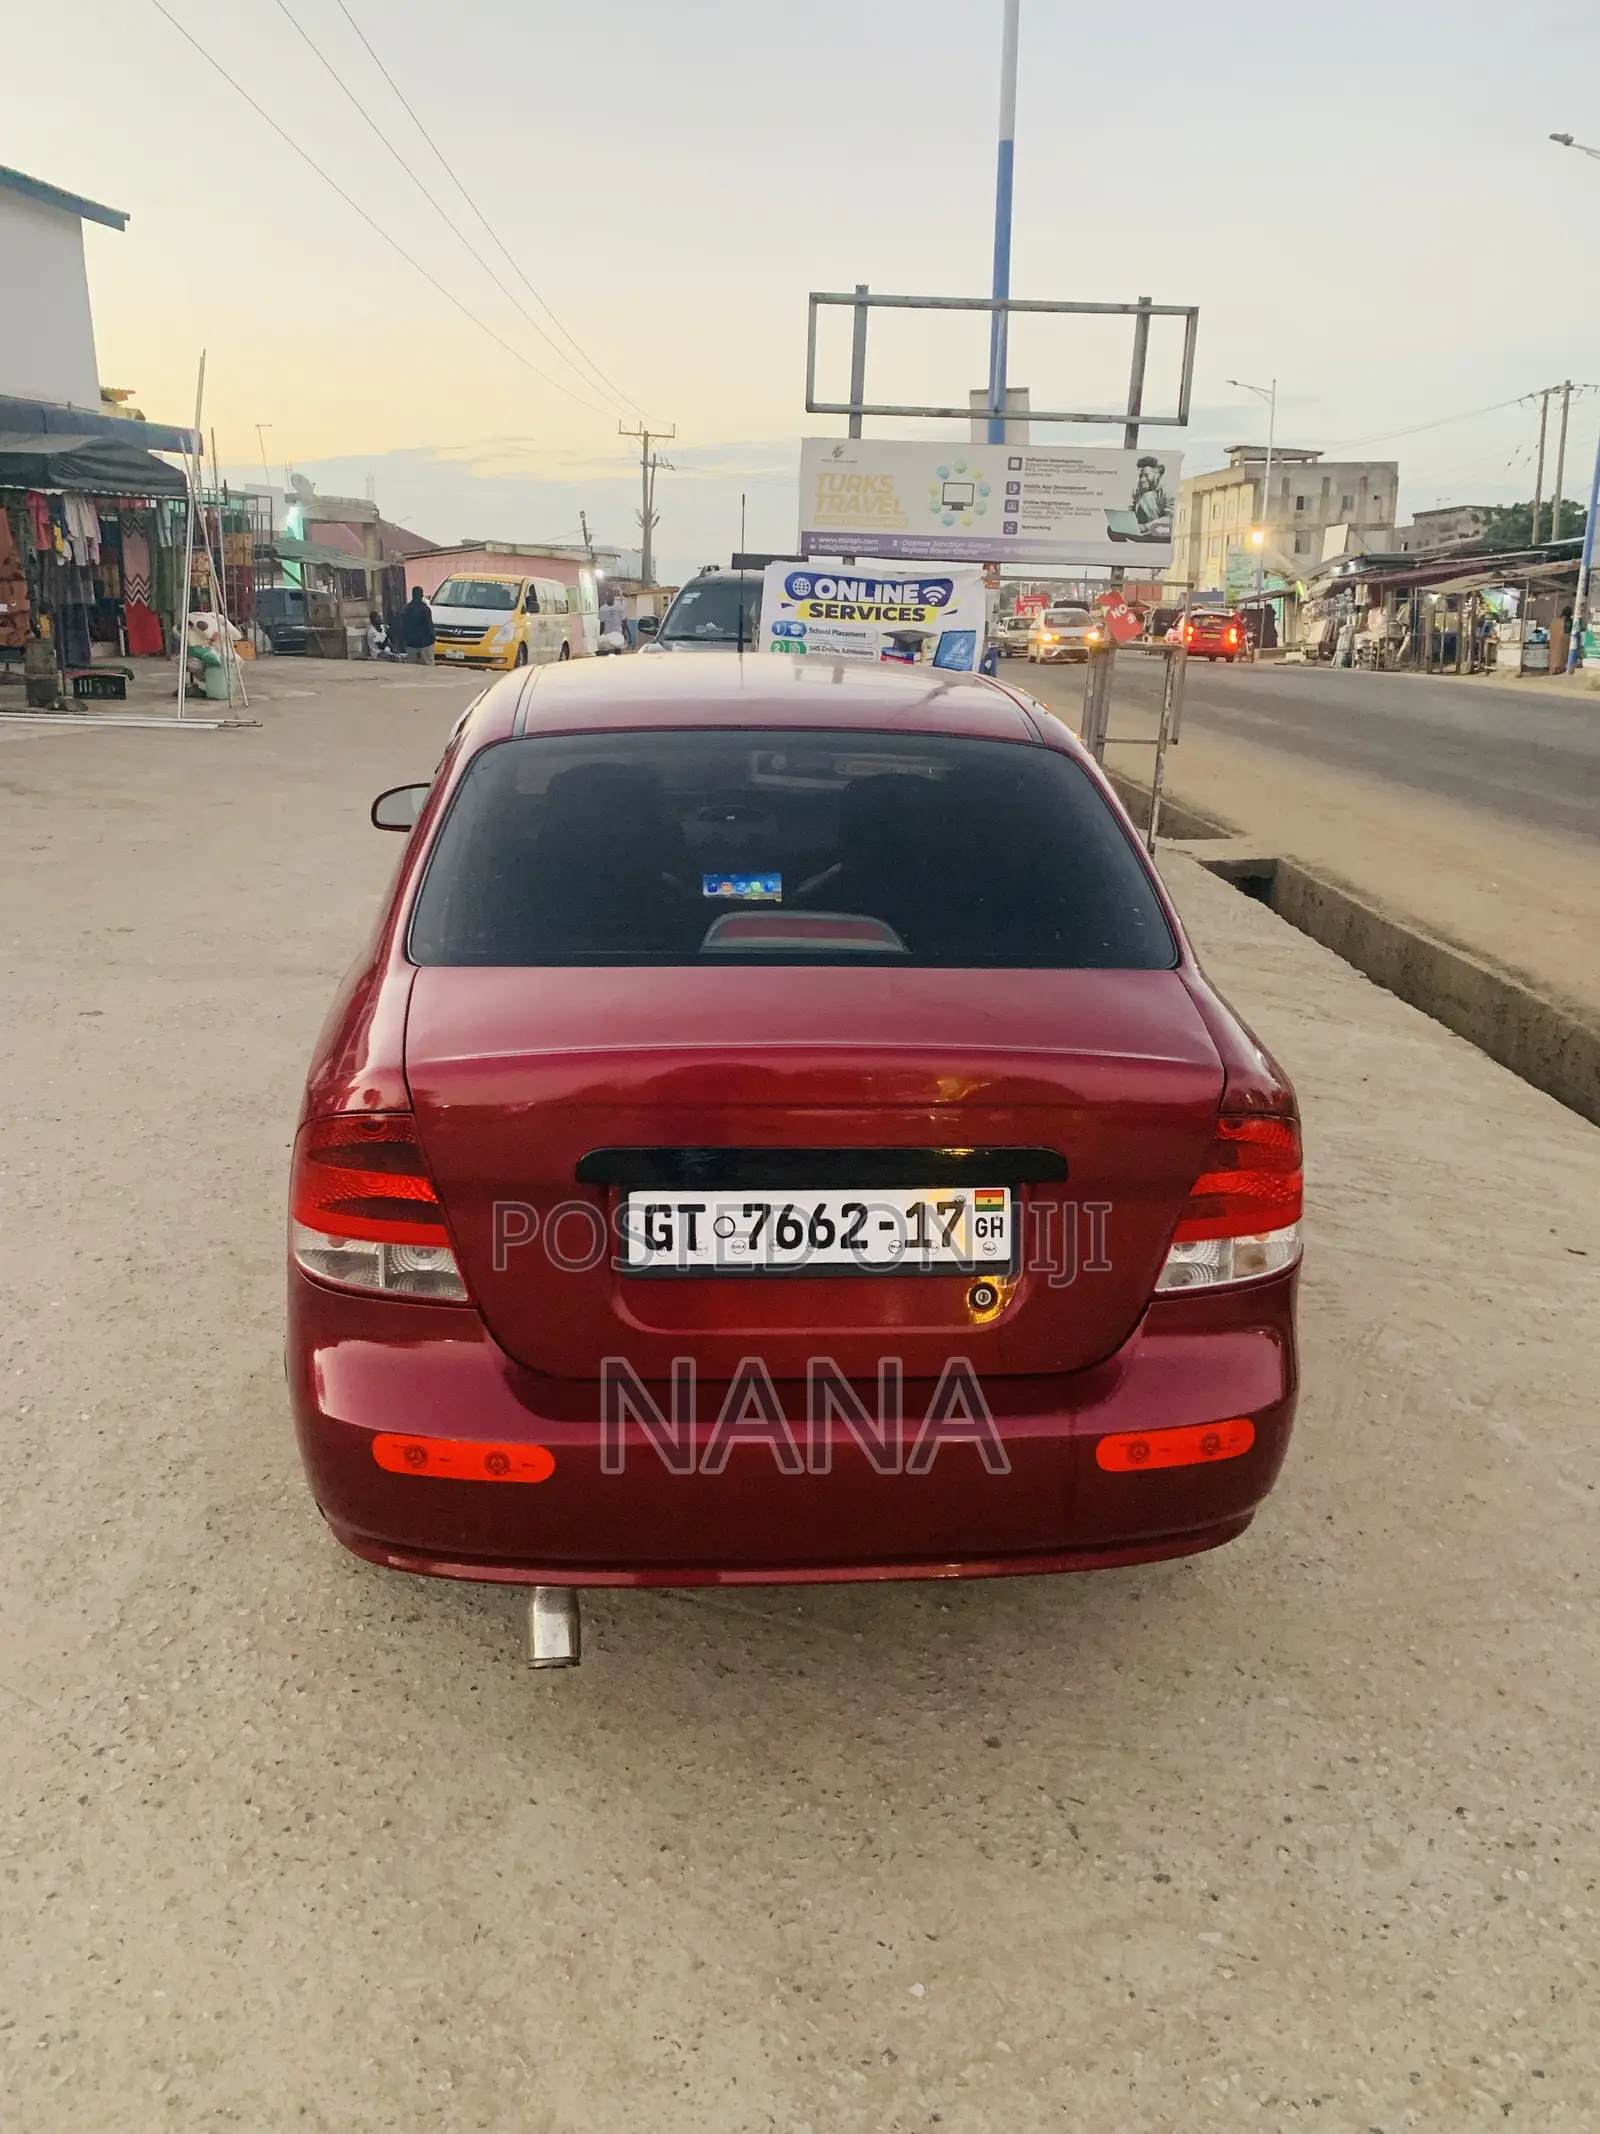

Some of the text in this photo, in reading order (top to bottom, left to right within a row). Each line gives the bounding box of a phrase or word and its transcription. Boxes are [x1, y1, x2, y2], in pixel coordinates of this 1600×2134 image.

[816, 472, 894, 494] TURKS
[815, 494, 905, 515] TRAVEL
[814, 578, 920, 605] ONLINE
[808, 602, 926, 622] SERVICES
[808, 627, 867, 639] School Placement
[821, 646, 840, 654] Online
[841, 647, 874, 657] Admissions
[644, 1201, 966, 1251] GT 7662-17
[975, 1216, 1004, 1239] GH
